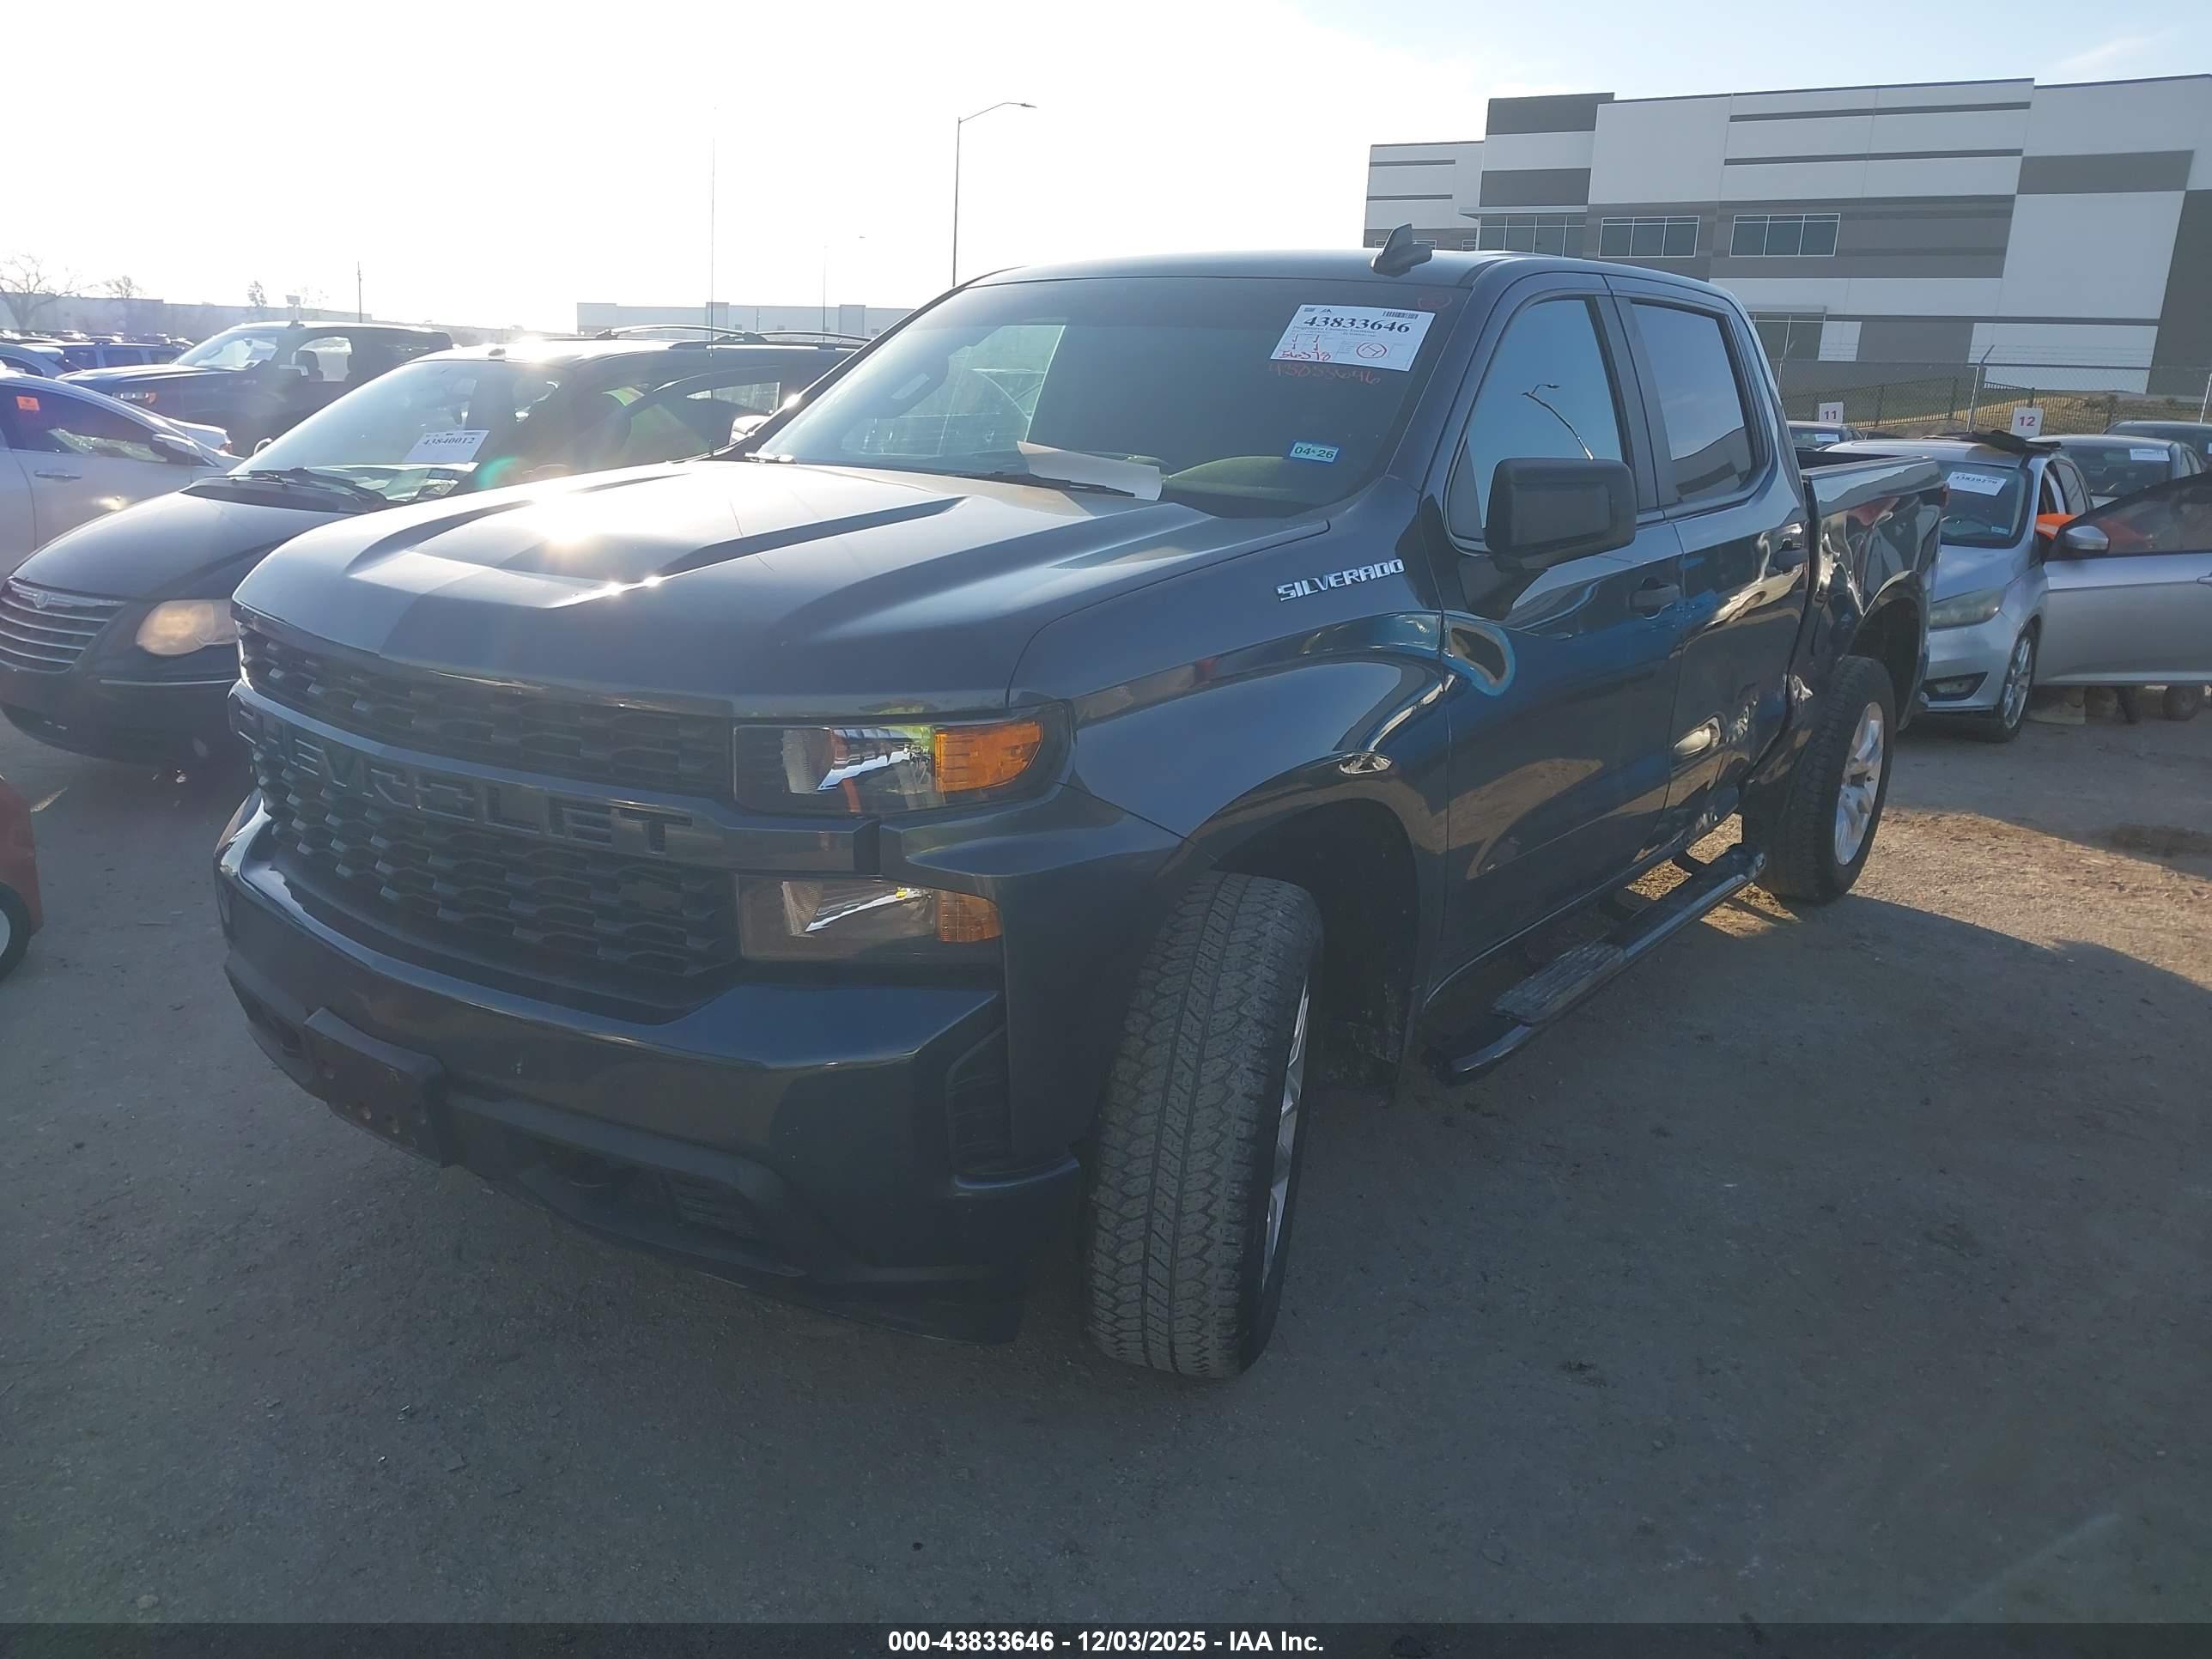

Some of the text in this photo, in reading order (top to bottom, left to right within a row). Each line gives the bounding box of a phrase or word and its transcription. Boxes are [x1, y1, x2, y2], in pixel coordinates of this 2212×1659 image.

[1303, 316, 1413, 333] 43833646
[1824, 410, 1838, 420] 11
[2019, 416, 2035, 427] 12
[1277, 559, 1406, 601] SILVERADO
